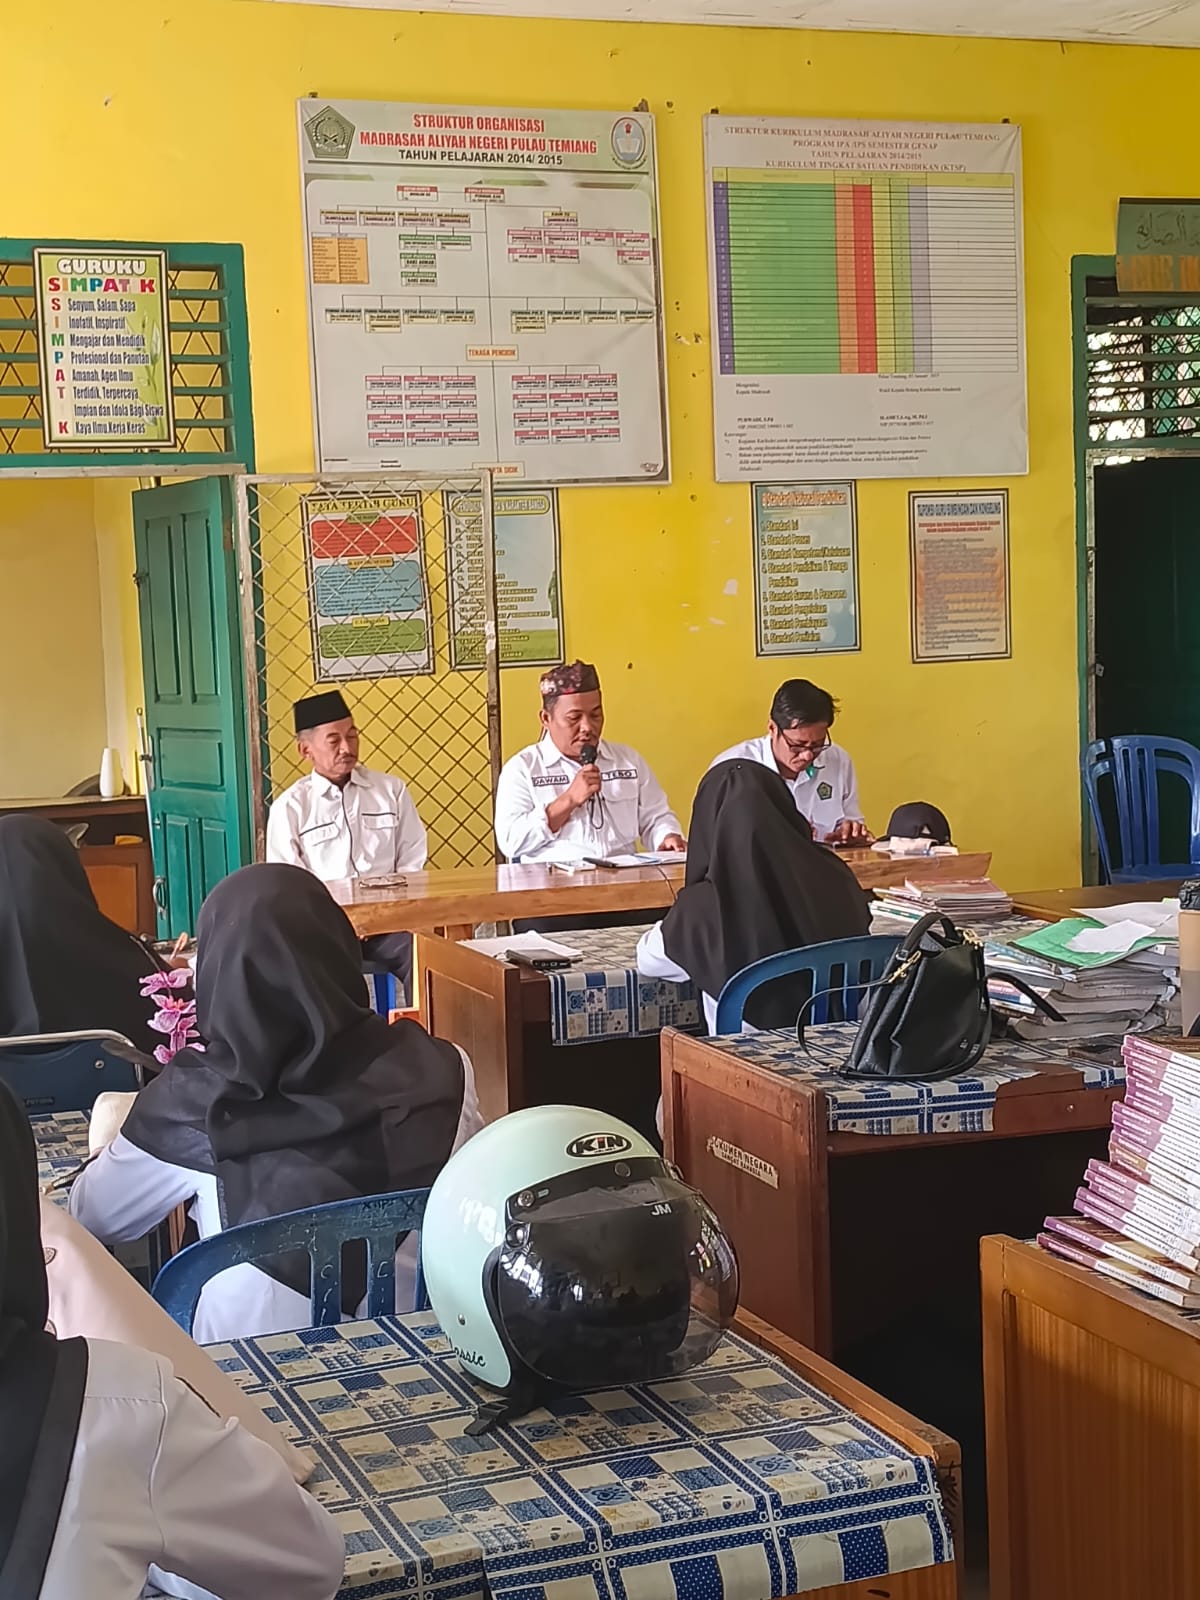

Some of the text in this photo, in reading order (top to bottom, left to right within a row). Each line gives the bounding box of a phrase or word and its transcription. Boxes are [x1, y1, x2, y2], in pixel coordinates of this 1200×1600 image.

[414, 114, 545, 132] STRUKTUR ORGANISASI
[770, 128, 822, 137] KURIKULUM
[824, 130, 869, 138] MADRASAH
[872, 131, 902, 139] ALIYAH
[904, 132, 934, 140] NEGERI
[360, 132, 597, 153] MADRASAH ALIYAH NEGERI PULAU TEMIANG
[399, 150, 437, 160] TAHUN
[440, 151, 504, 162] PELAJARAN
[538, 154, 563, 165] 2015
[765, 160, 816, 168] KURIKULUM
[818, 161, 854, 169] TINGKAT
[857, 162, 888, 170] SATUAN
[890, 163, 939, 171] PENDIDIKAN
[57, 258, 147, 276] GURUKU
[51, 297, 61, 312] S
[52, 333, 64, 346] M
[70, 334, 101, 348] Mengajar
[102, 334, 114, 347] dan
[54, 352, 63, 364] P
[110, 352, 122, 364] dan
[56, 369, 65, 381] A
[102, 369, 117, 383] Agen
[56, 386, 66, 399] T
[99, 404, 110, 416] dan
[58, 421, 68, 434] K
[534, 776, 566, 784] DAWAM
[744, 1153, 773, 1176] NEGARA
